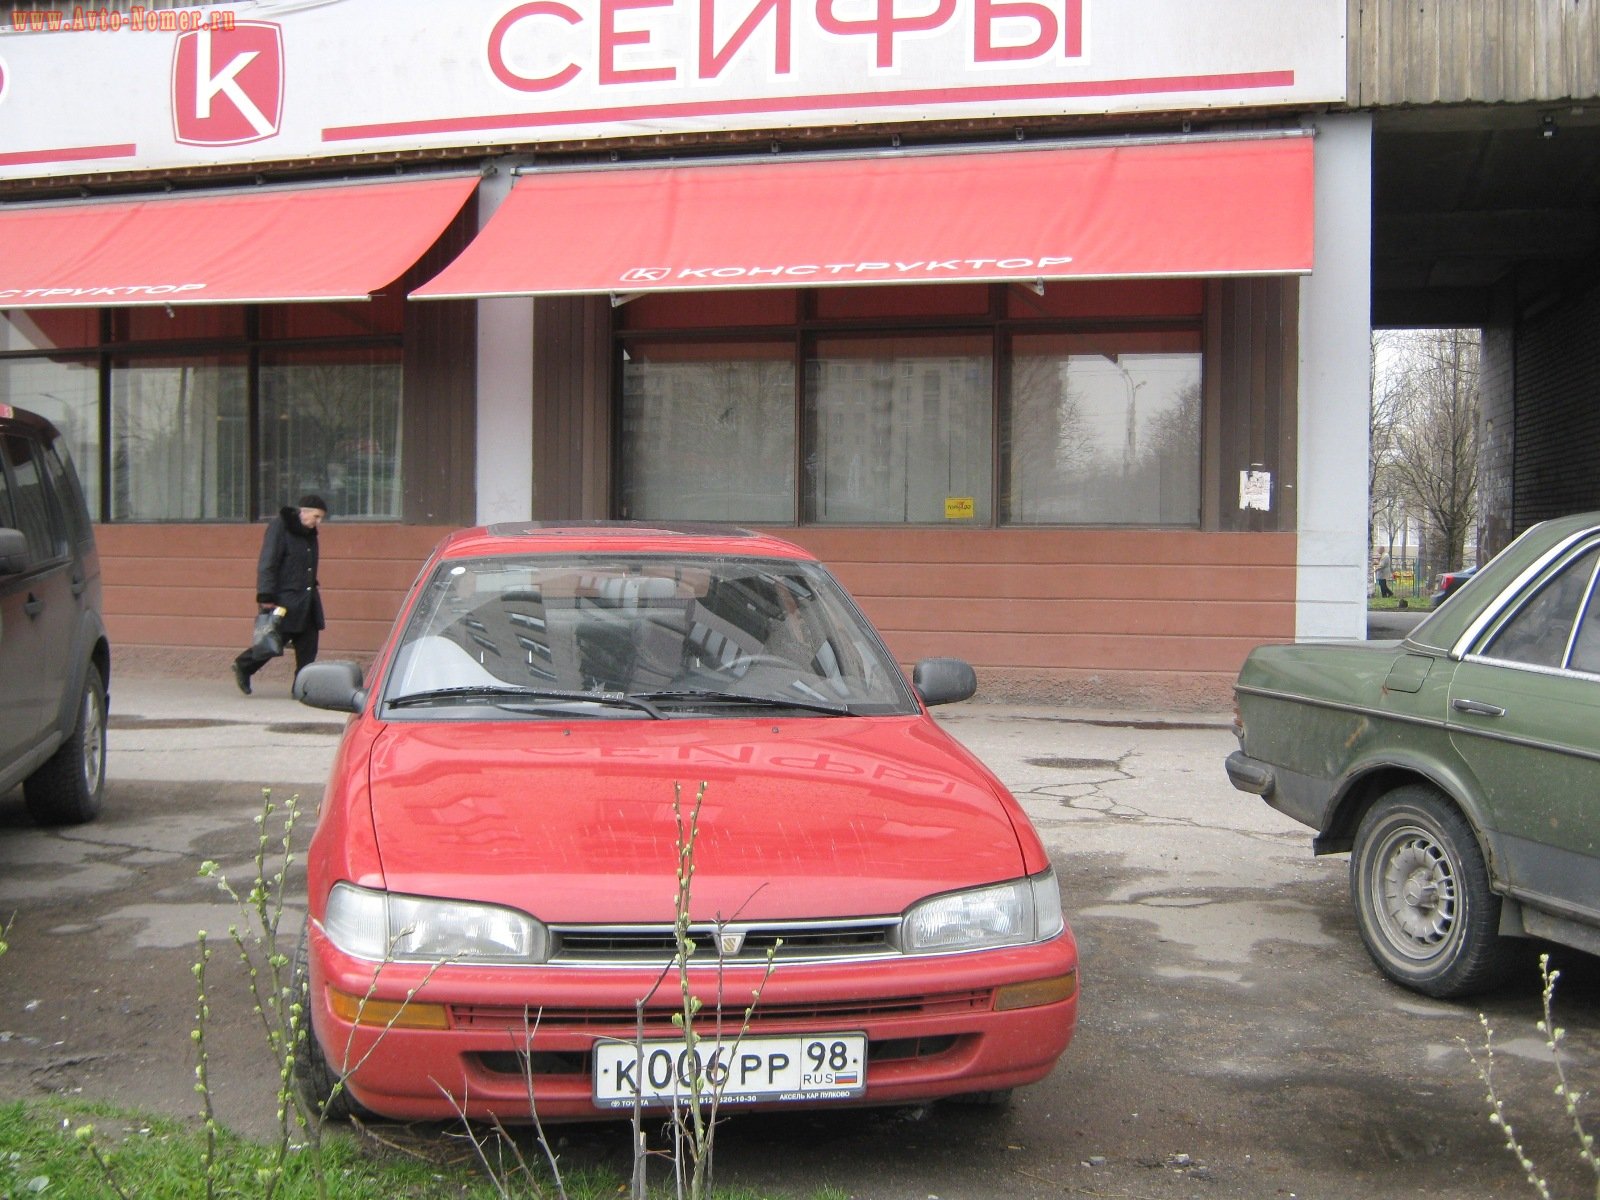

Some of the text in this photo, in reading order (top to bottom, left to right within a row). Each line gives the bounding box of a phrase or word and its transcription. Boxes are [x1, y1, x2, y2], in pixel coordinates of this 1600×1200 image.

[677, 257, 1073, 279] КОНСТРУКТОР
[807, 1041, 847, 1072] 98
[803, 1073, 833, 1084] RUS
[779, 1093, 805, 1101] АКСЕЛЬ
[820, 1090, 850, 1099] ПУЛКОВО
[622, 1099, 649, 1107] TOYTA
